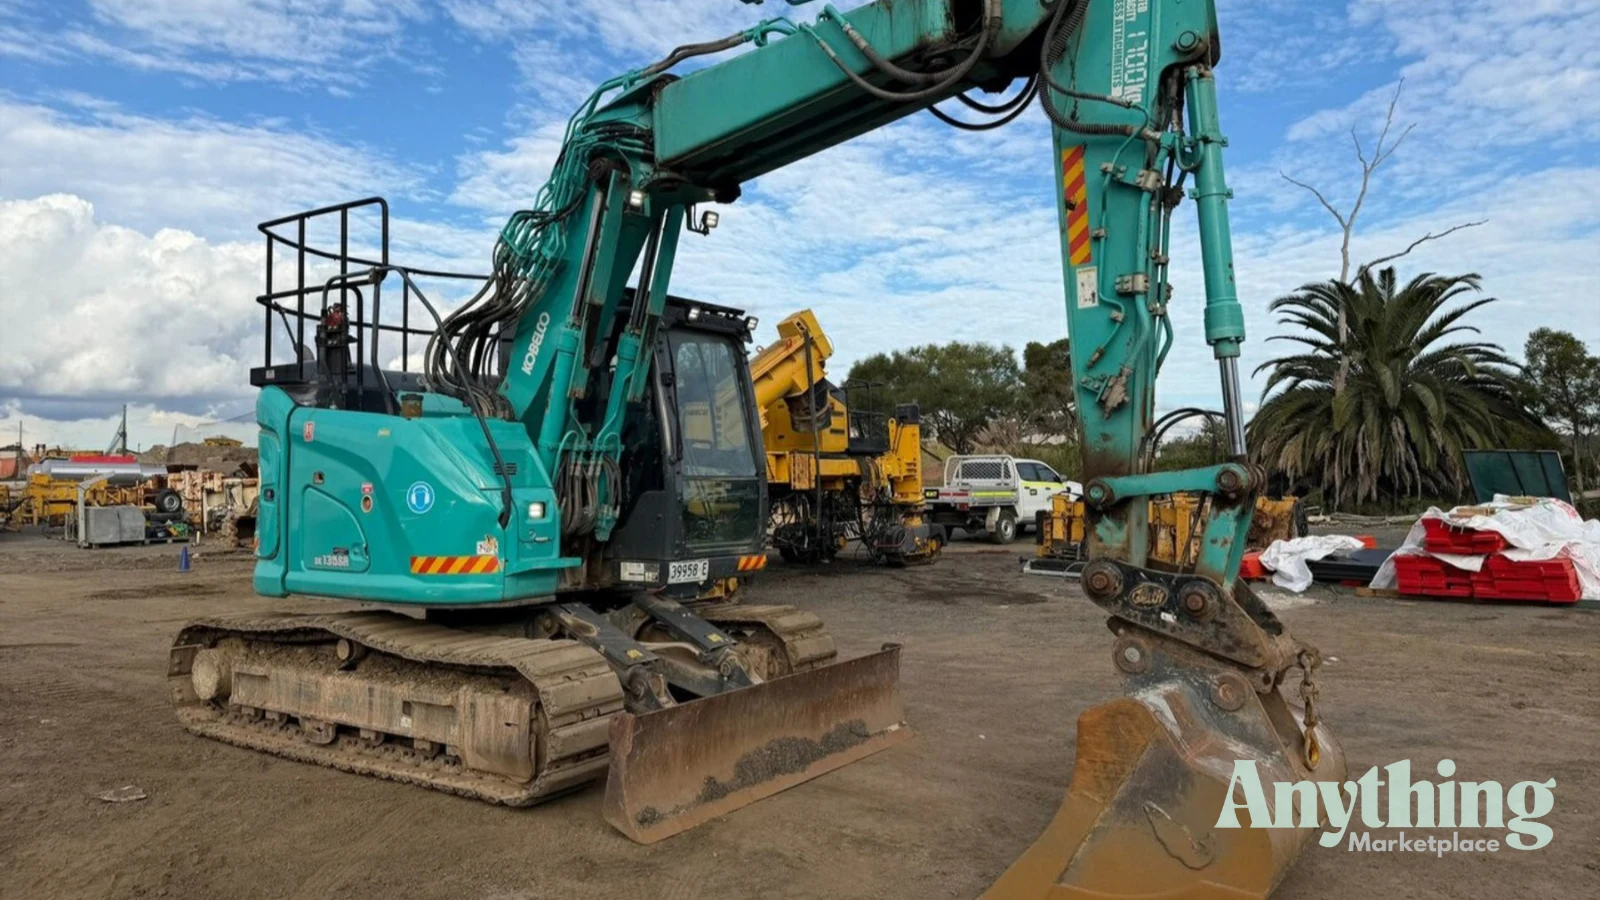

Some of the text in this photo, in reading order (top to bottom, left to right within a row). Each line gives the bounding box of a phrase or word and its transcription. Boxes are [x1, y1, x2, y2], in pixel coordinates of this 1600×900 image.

[1113, 19, 1123, 88] ATTACHMENTS
[521, 311, 551, 376] KOBELCO
[671, 563, 698, 579] 39958
